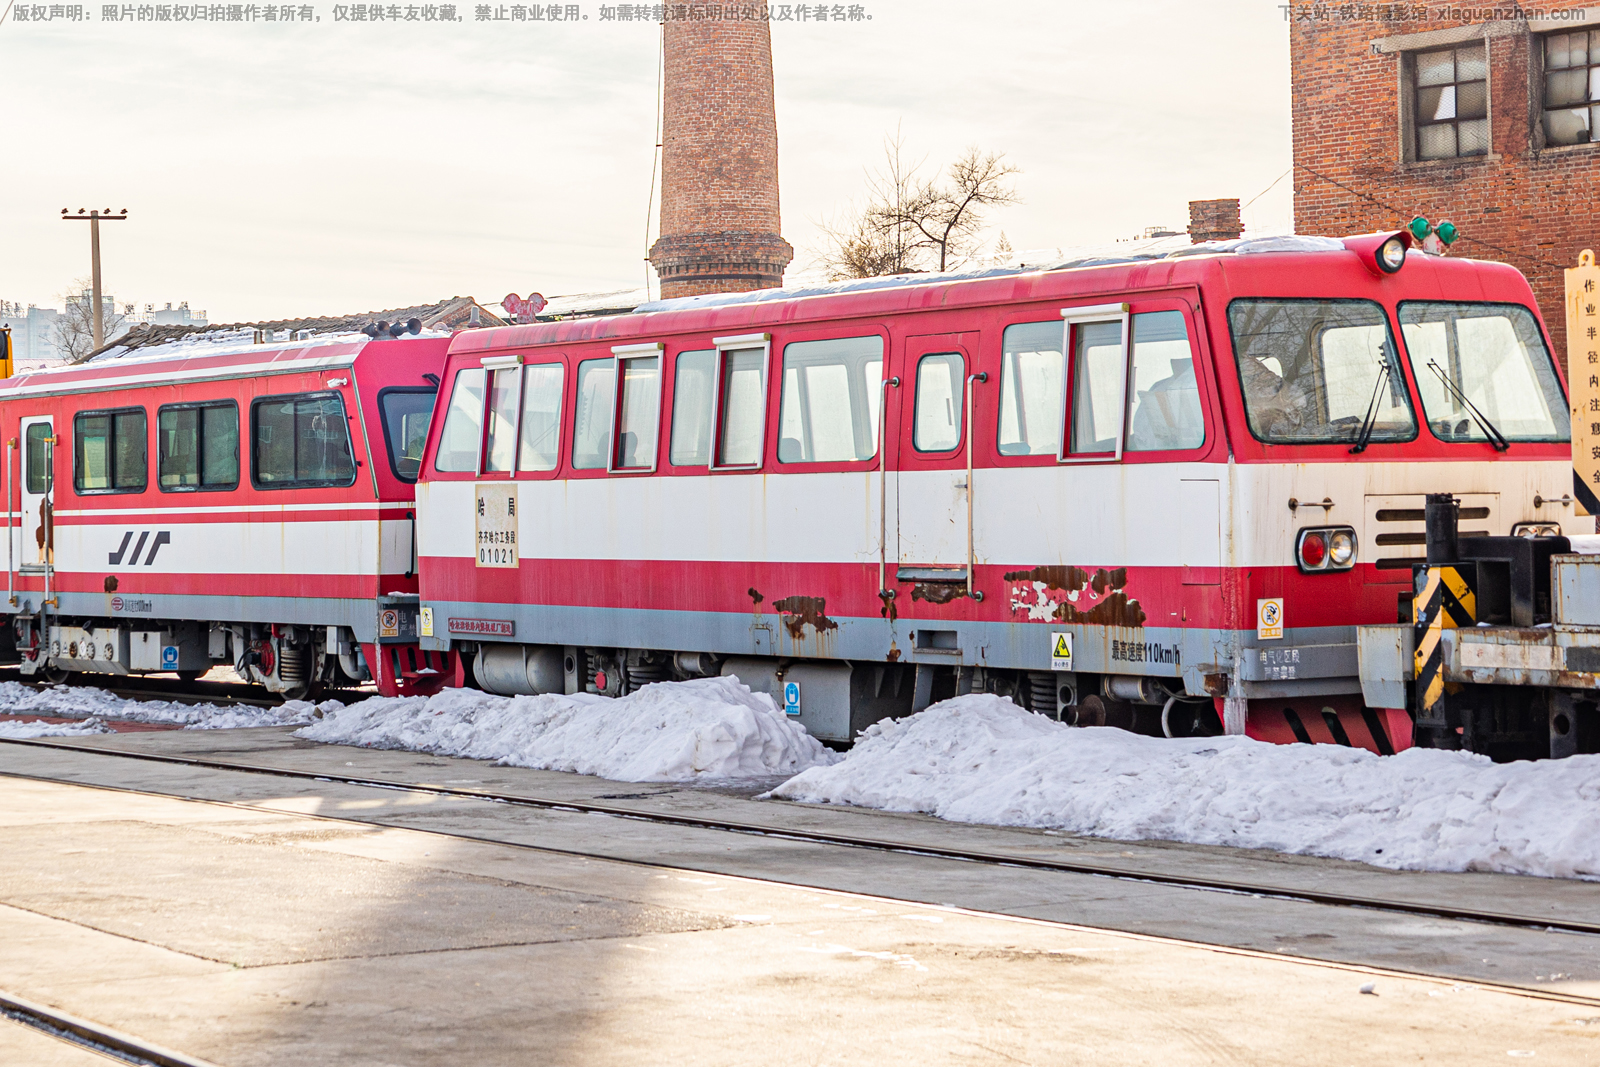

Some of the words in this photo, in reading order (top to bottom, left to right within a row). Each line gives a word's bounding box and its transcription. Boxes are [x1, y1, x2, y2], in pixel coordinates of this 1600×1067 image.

[478, 530, 515, 544] 齐齐哈尔工务段
[480, 547, 514, 563] 01021
[1112, 639, 1181, 665] 最高速度110km/h
